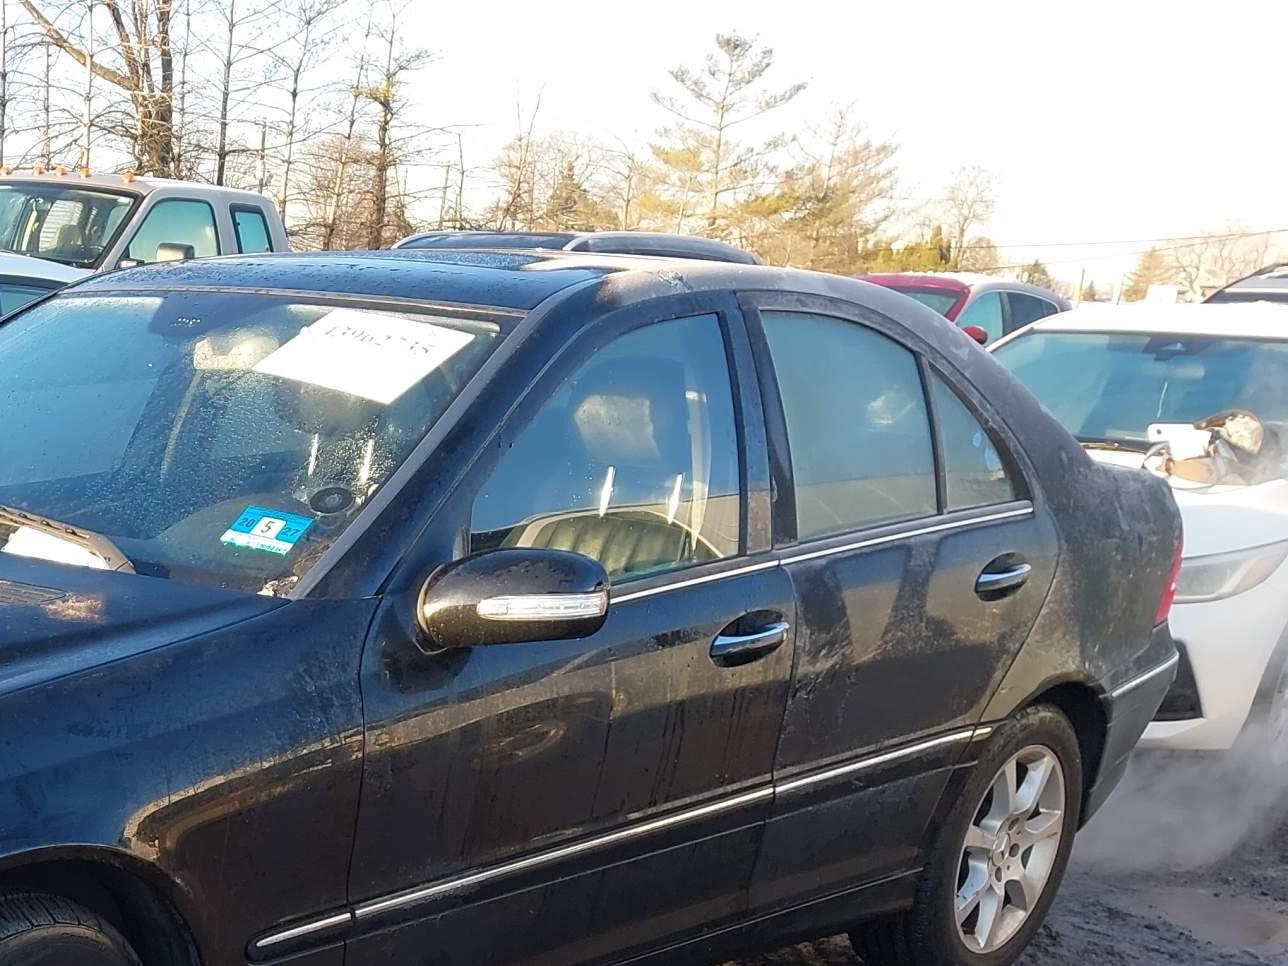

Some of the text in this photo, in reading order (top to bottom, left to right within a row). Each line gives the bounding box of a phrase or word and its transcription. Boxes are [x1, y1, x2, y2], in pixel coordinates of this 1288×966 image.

[238, 517, 301, 543] 20 5 27
